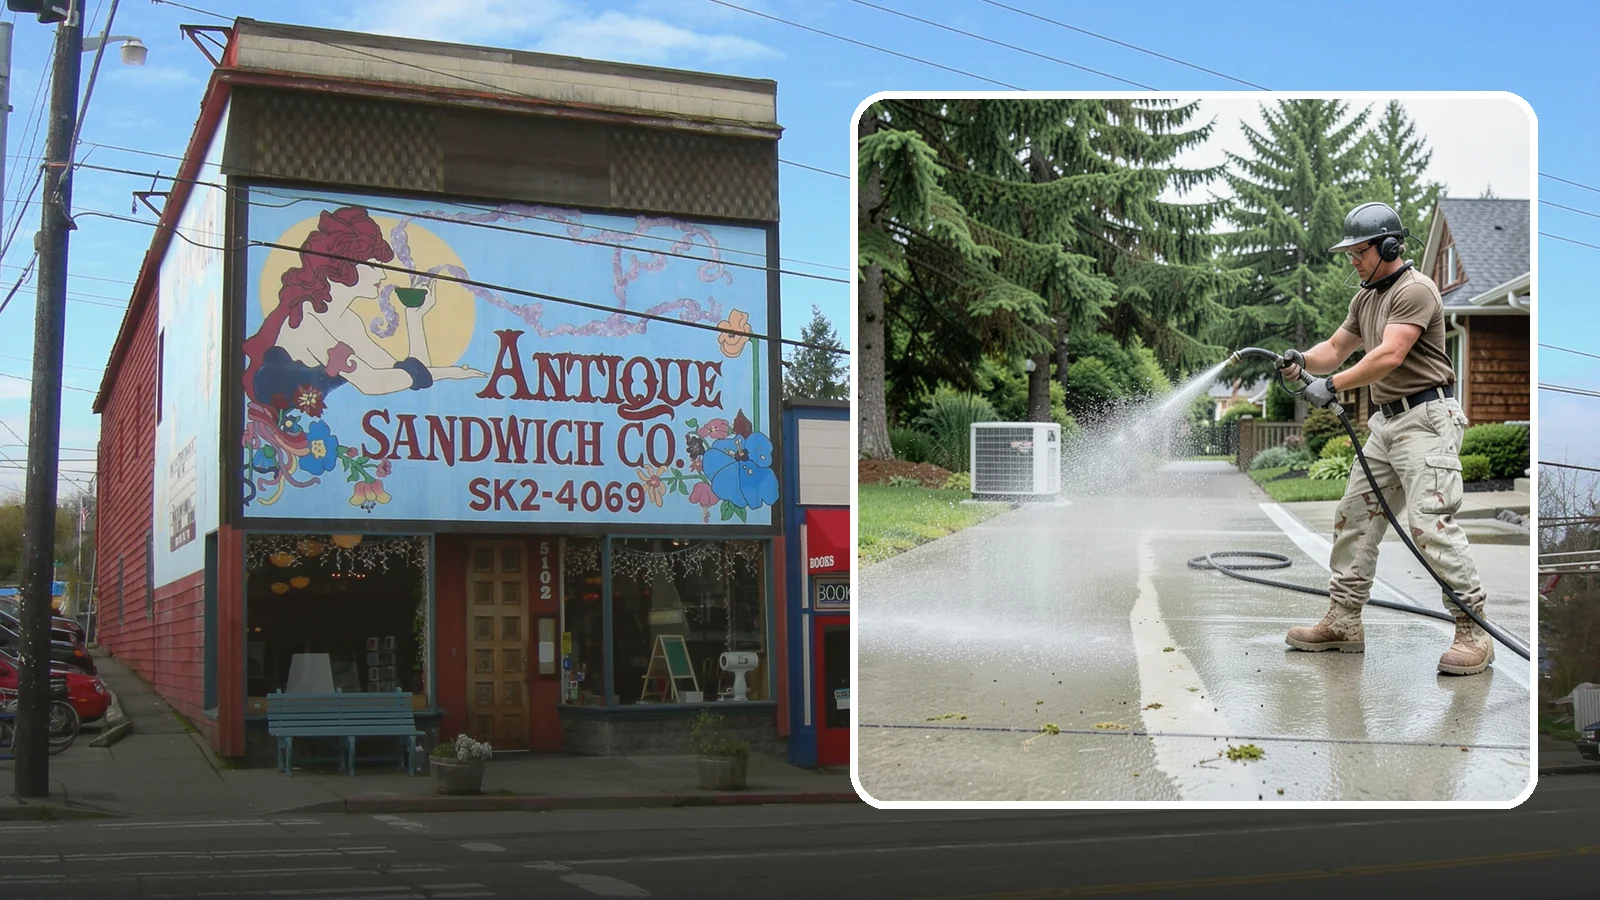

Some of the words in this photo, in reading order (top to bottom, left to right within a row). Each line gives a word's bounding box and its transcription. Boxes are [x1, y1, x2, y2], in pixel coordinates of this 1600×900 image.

[475, 329, 724, 421] ANTIQUE
[361, 408, 604, 467] SANDWICH
[617, 422, 685, 468] CO.
[468, 477, 645, 513] SK2-4069
[540, 541, 551, 600] 5102
[810, 555, 834, 568] BOOKS
